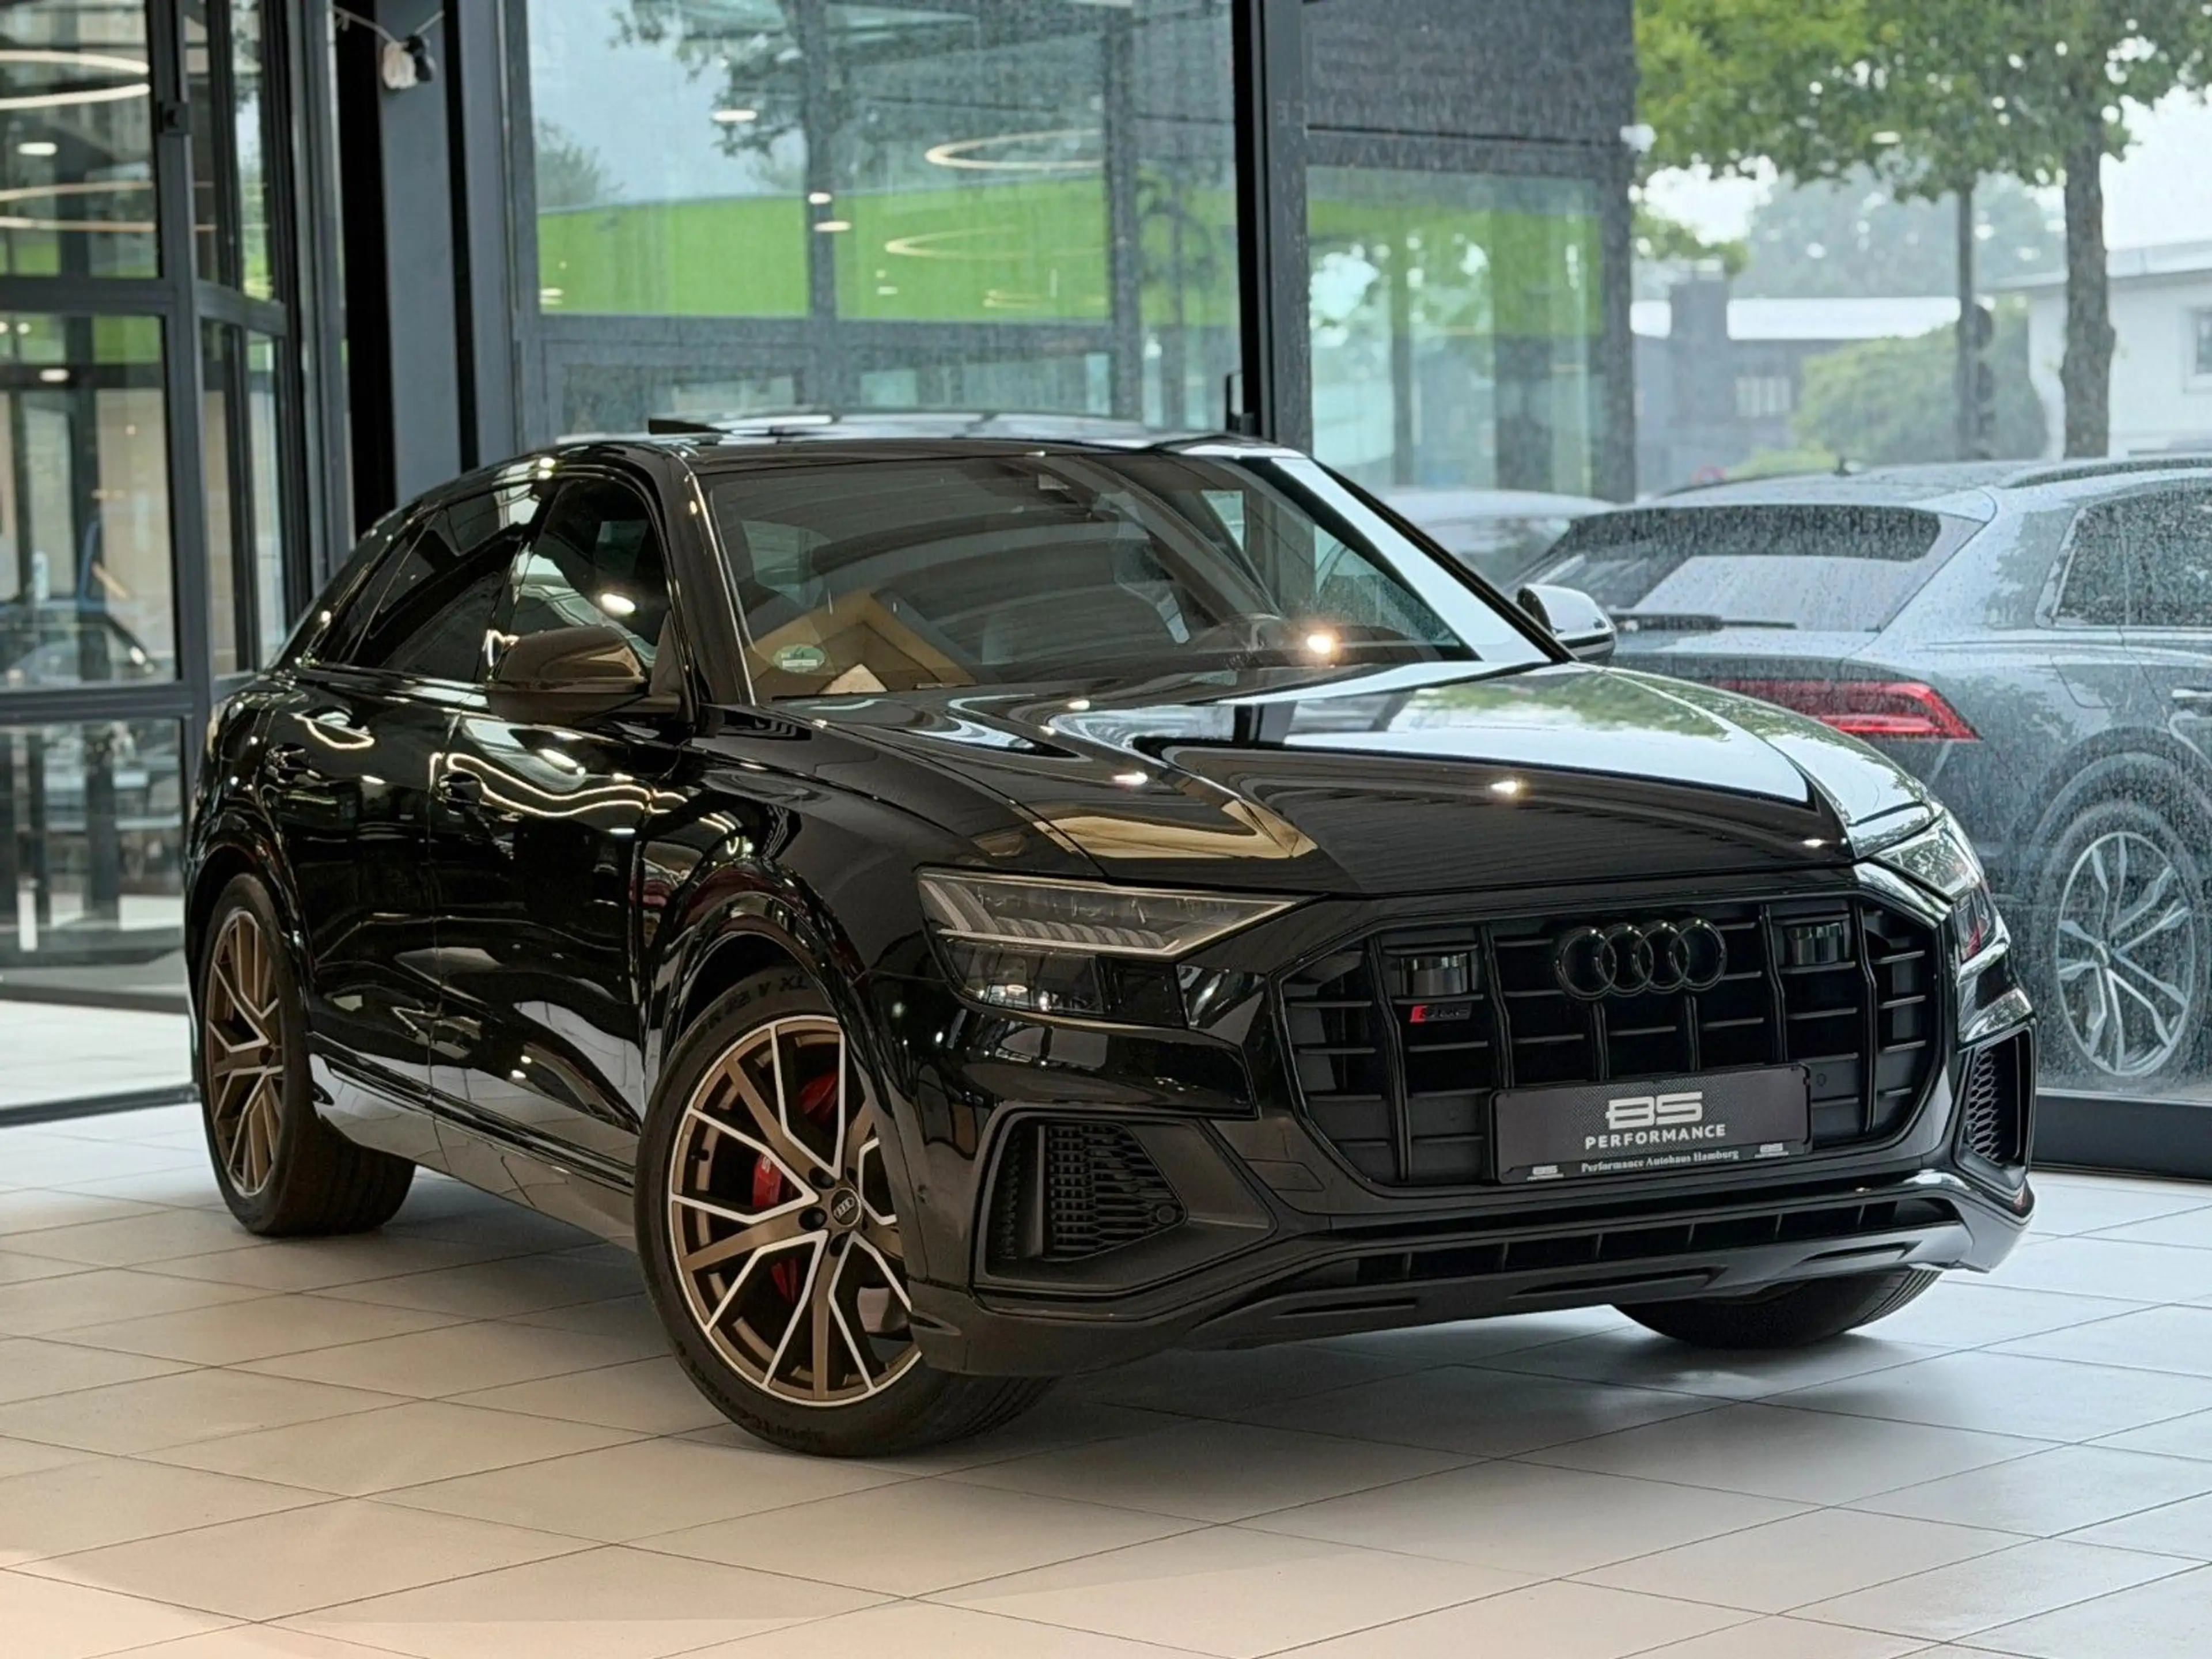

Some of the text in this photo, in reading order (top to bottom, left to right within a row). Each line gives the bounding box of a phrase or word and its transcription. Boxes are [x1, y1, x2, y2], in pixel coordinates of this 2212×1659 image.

[1585, 1124, 1726, 1150] PERFORMANCE
[1581, 1150, 1738, 1173] Performance Autohaus Hamburg
